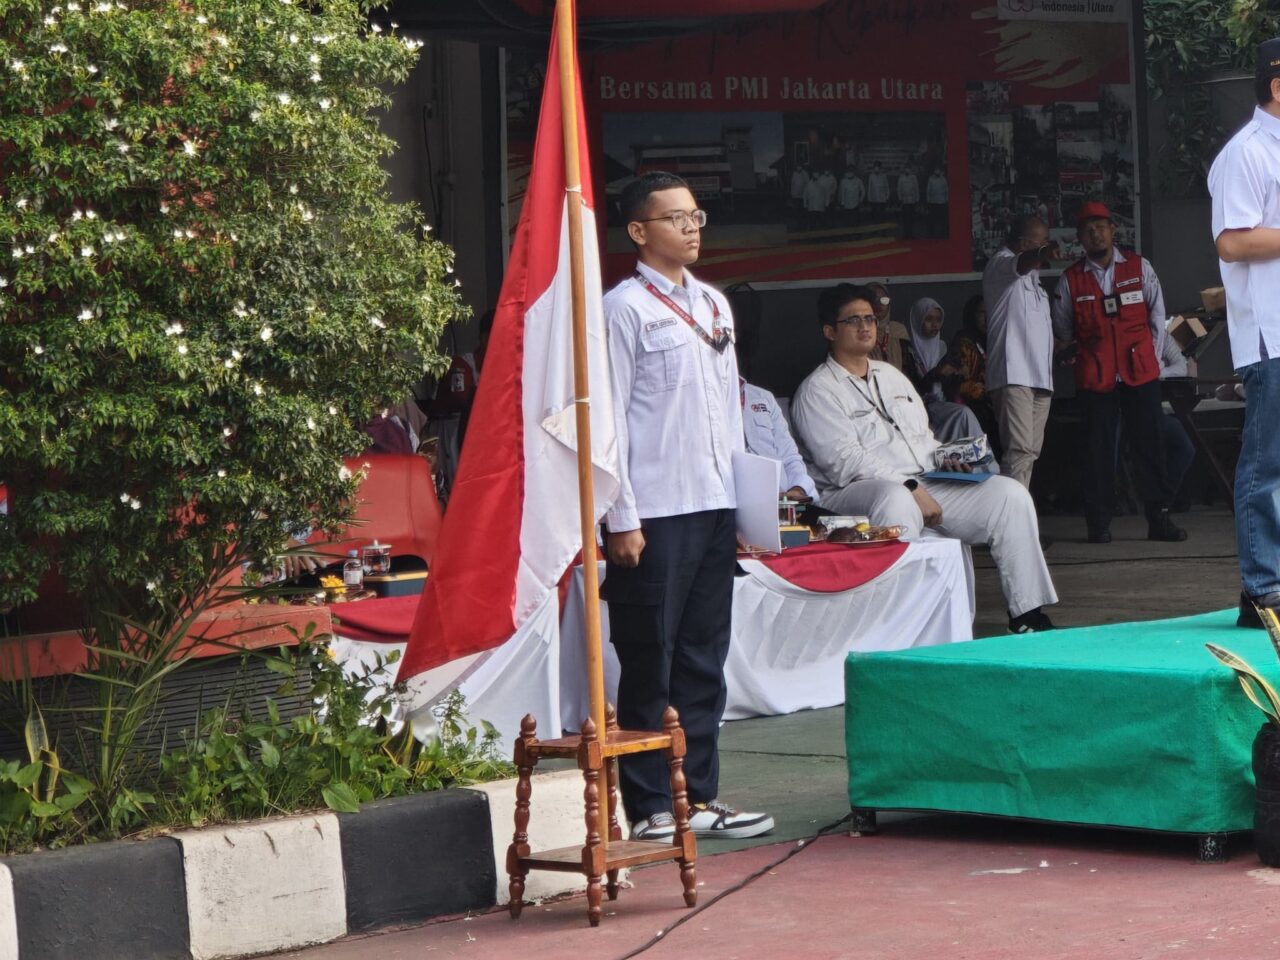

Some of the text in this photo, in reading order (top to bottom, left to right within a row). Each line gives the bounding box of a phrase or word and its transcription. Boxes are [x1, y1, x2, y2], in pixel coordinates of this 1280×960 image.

[1041, 1, 1085, 13] Indonesia
[1091, 2, 1114, 13] Utara
[600, 75, 944, 100] Bersama PMI Jakarta Utara
